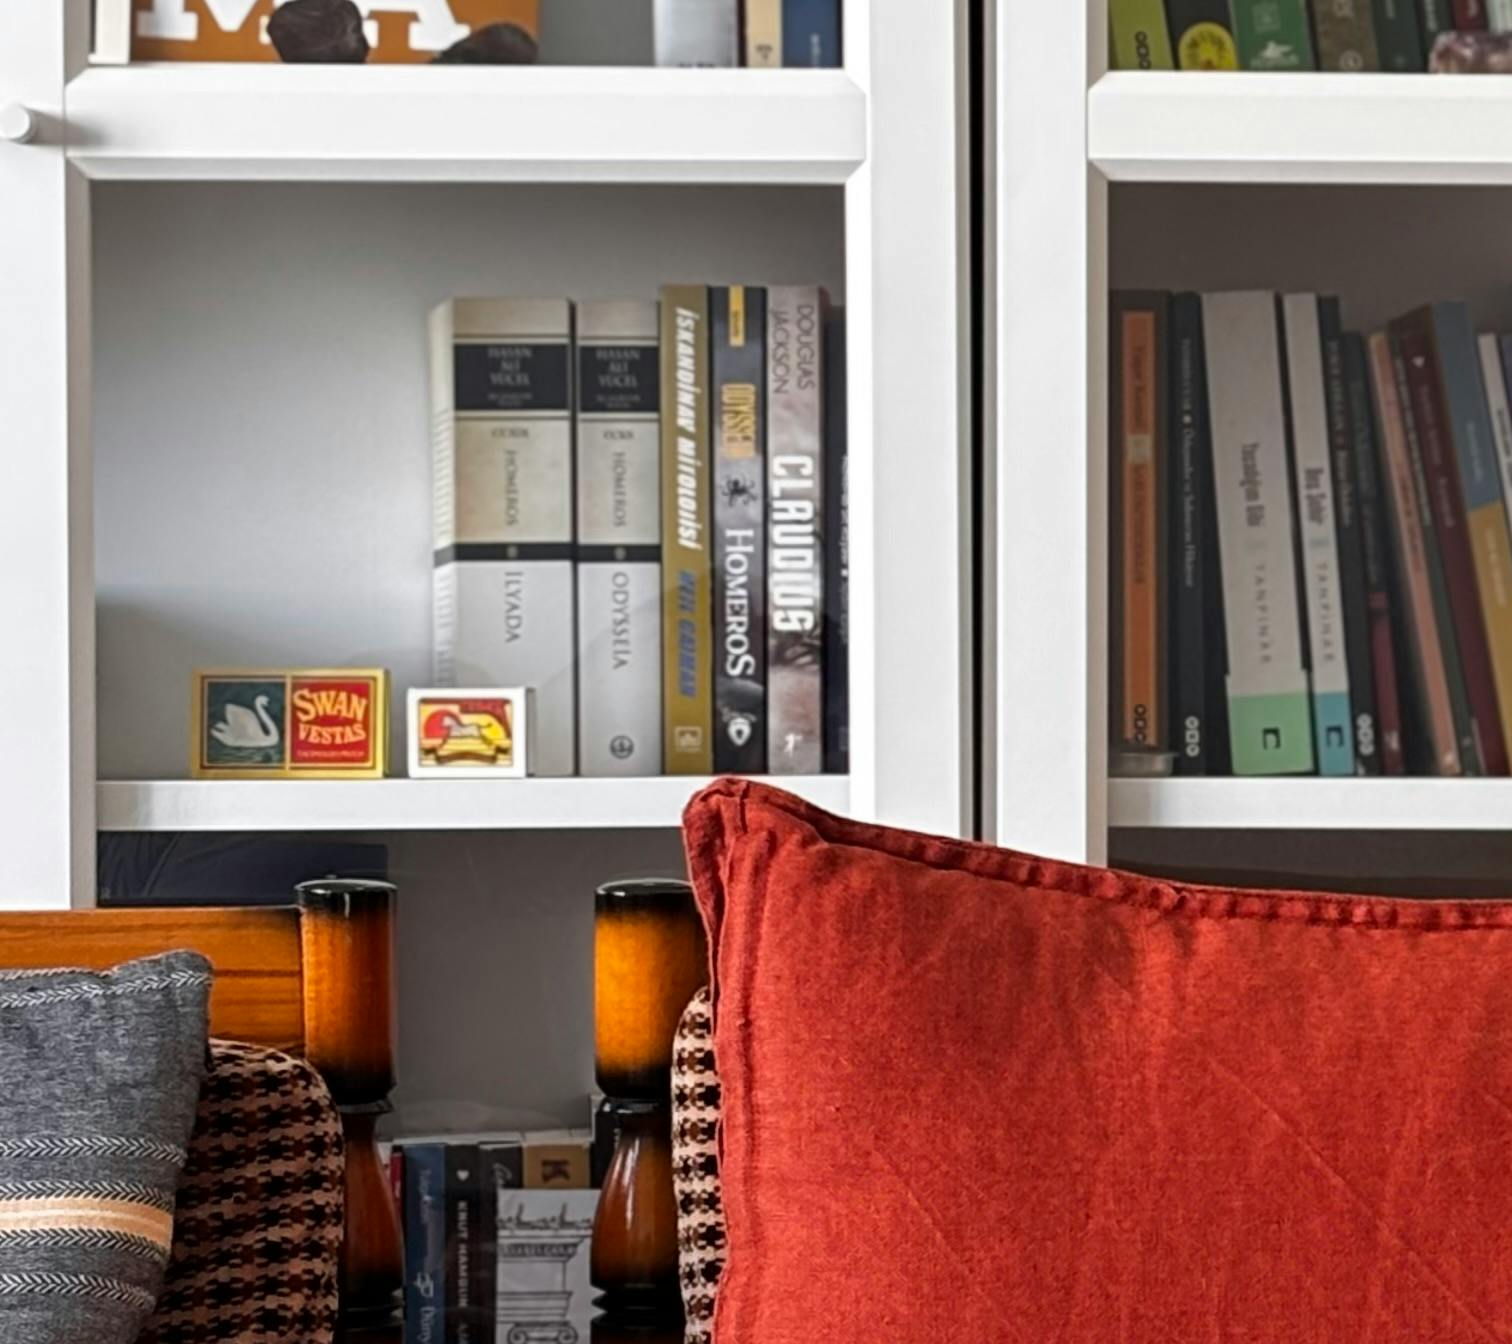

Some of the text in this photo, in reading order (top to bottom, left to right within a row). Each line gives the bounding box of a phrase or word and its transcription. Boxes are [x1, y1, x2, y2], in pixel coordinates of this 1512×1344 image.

[771, 310, 790, 395] JACKSON
[795, 304, 815, 391] DOUGLAS
[676, 307, 703, 550] İSKANDİNAV MİTOLOJİSİ
[504, 450, 520, 526] HOMEROS
[612, 451, 627, 528] HOMEROS
[769, 455, 815, 632] CLAUDIUS
[725, 528, 755, 677] HOMEROS
[1253, 563, 1274, 663] TANPINAR
[1316, 562, 1336, 662] TANPINAR
[293, 688, 368, 722] SWAN
[298, 722, 368, 745] VESTAS
